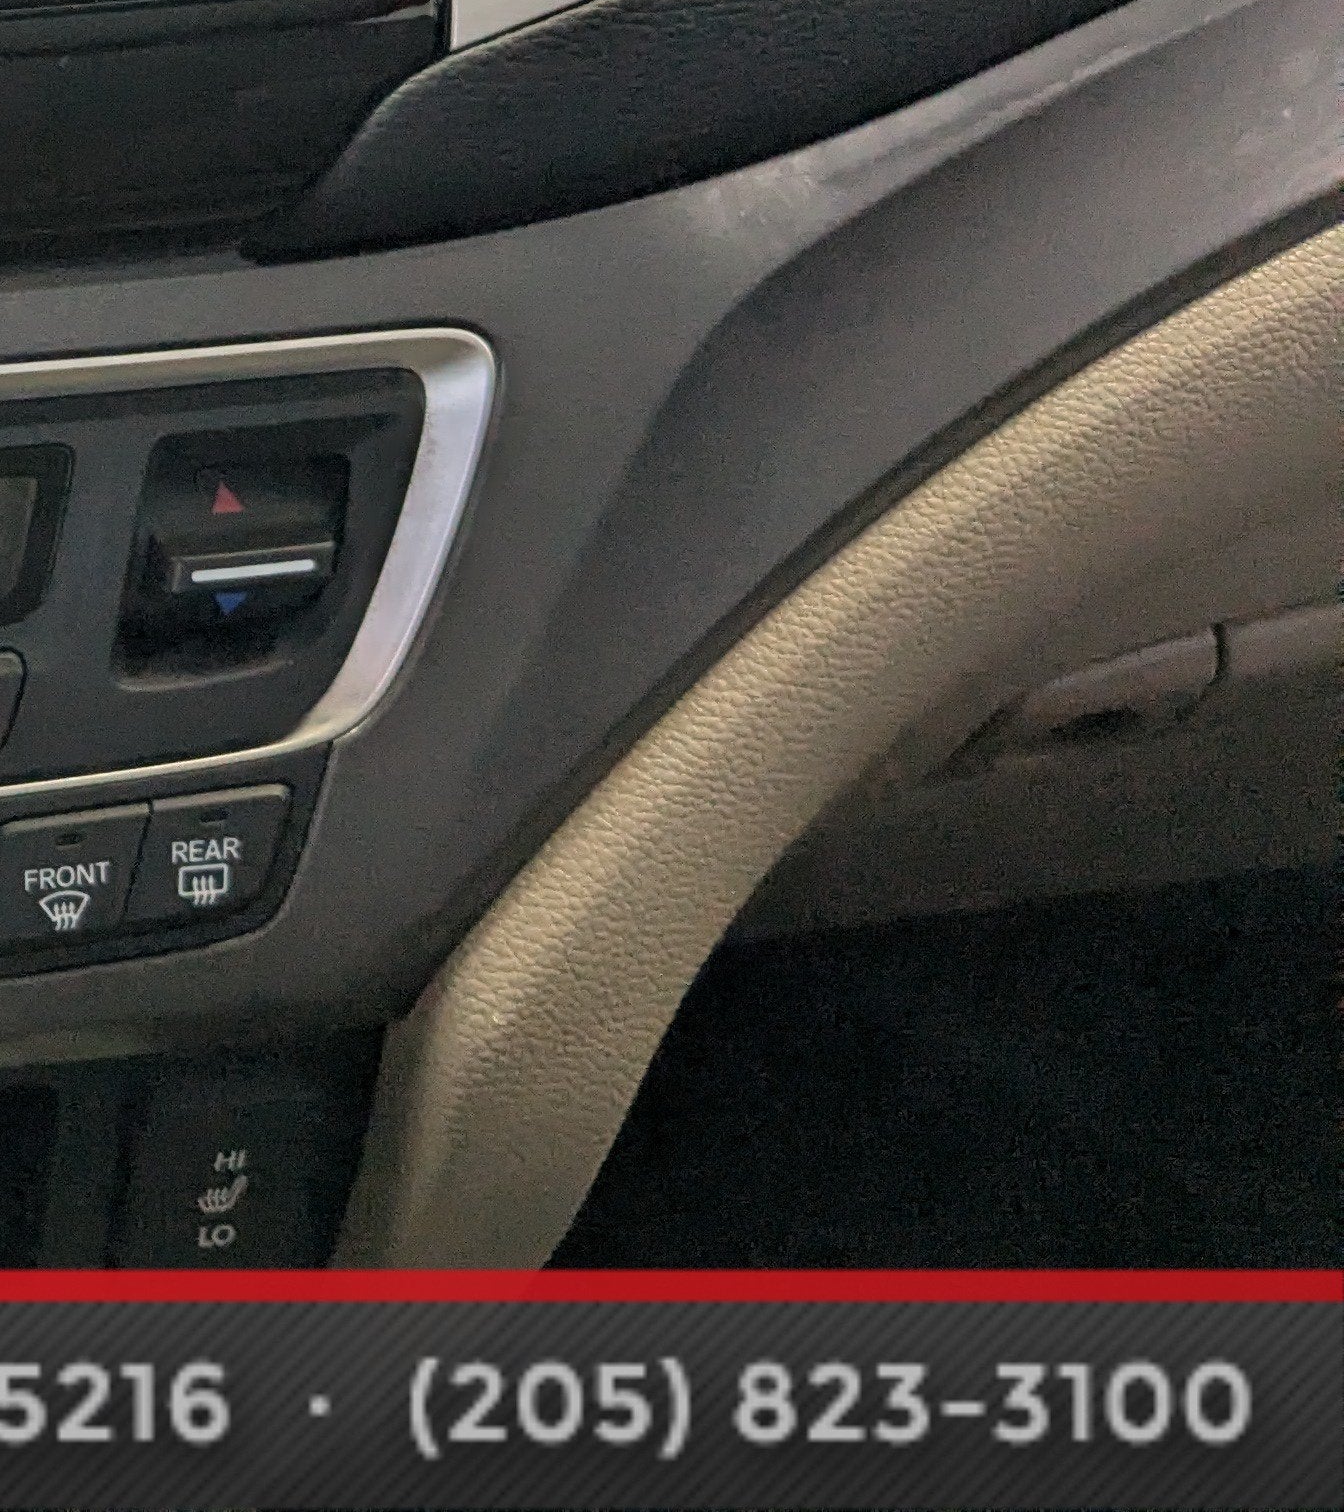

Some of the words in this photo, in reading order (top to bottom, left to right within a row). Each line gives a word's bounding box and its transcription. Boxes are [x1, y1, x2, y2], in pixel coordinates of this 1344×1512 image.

[171, 837, 240, 865] REAR
[23, 861, 110, 891] FRONT
[214, 1150, 246, 1171] HI
[198, 1224, 236, 1248] LO
